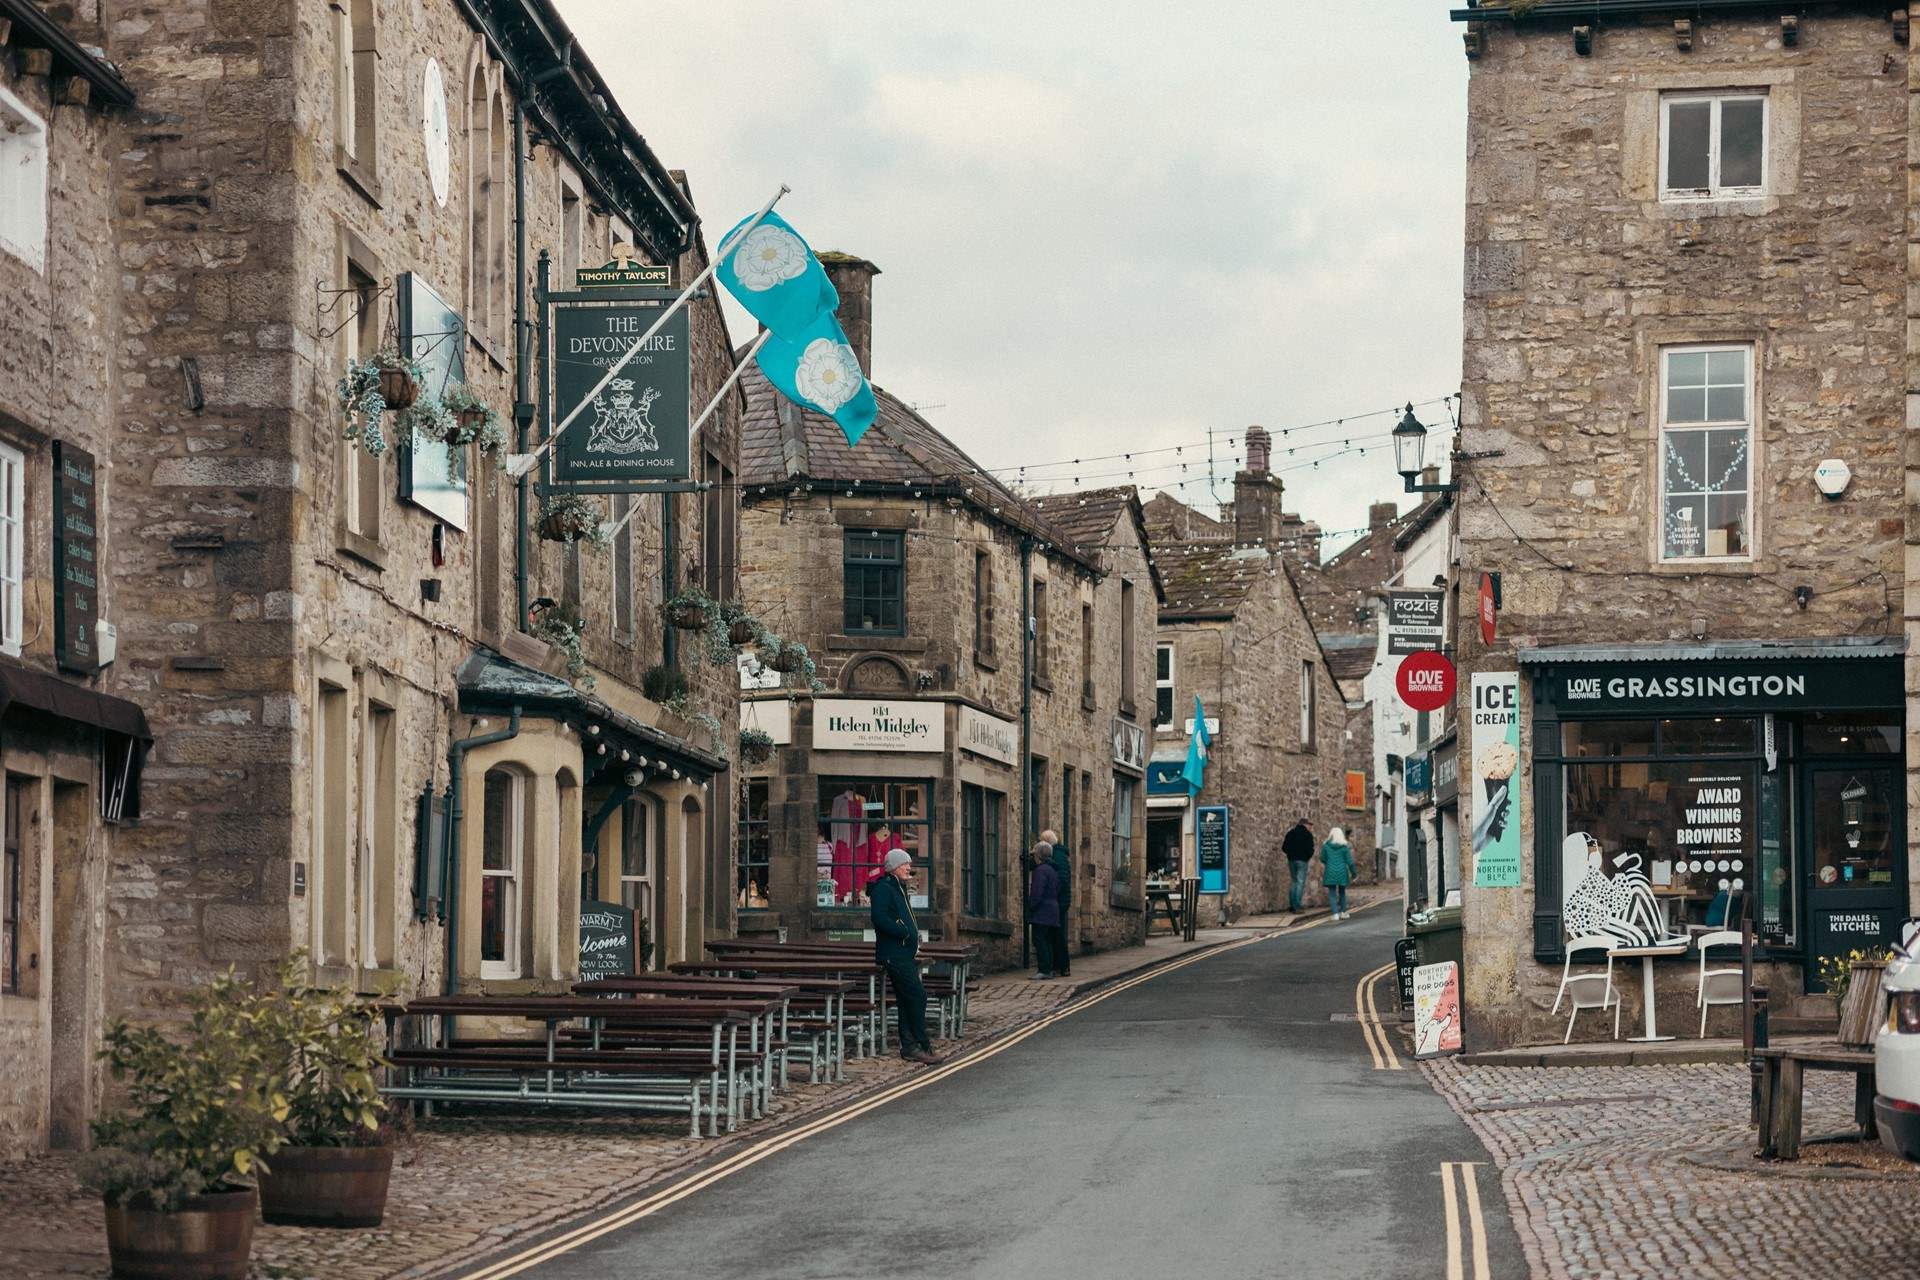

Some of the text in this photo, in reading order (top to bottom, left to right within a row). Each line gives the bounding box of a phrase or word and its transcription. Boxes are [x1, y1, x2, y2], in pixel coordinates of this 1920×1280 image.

[579, 271, 666, 281] TIMOTHY TAYLOR'S
[606, 317, 639, 332] THE
[590, 460, 603, 468] ALE
[1408, 670, 1444, 684] LOVE
[1408, 684, 1444, 692] BROWNIES
[1567, 679, 1600, 692] LOVE
[1607, 675, 1804, 698] GRASSINGTON
[1476, 685, 1516, 709] ICE
[1475, 713, 1516, 725] CREAM
[829, 716, 930, 738] Helen Midgley
[1697, 788, 1741, 804] AWARD
[1685, 808, 1742, 824] WINNING
[1677, 828, 1742, 844] BROWNIES
[1477, 865, 1517, 873] NORTHERN
[1846, 914, 1870, 922] DALES
[1830, 922, 1880, 932] KITCHEN
[580, 934, 627, 953] lcome
[598, 960, 619, 968] LOOK
[1401, 967, 1412, 976] ICE
[1405, 978, 1412, 986] IS
[1418, 984, 1431, 992] FOR
[1434, 979, 1454, 989] DOGS
[1405, 987, 1414, 996] FO
